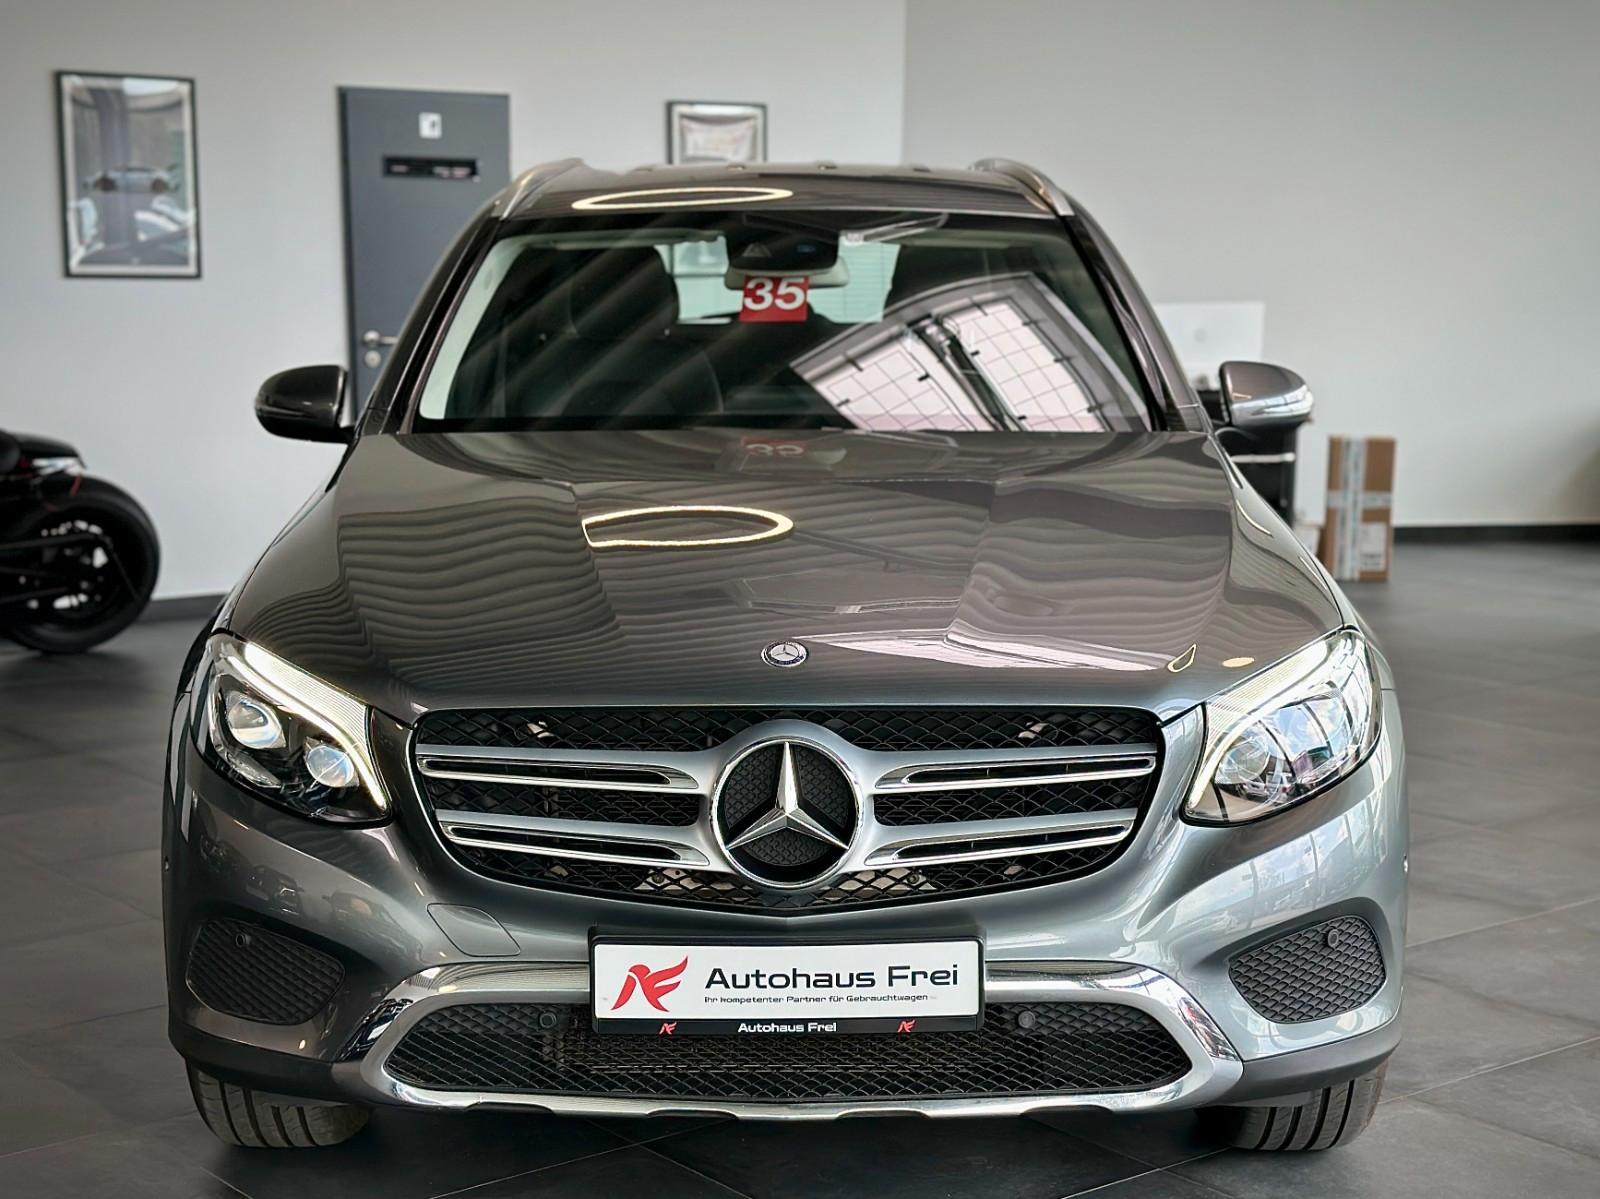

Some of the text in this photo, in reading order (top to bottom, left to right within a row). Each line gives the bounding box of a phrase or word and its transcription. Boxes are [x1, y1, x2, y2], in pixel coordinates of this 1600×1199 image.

[743, 277, 806, 310] 35
[704, 964, 958, 989] Autohaus Frei
[704, 996, 719, 1004] Ihr
[720, 995, 785, 1005] kompetenter
[786, 995, 827, 1004] Partner
[829, 995, 844, 1003] für
[846, 994, 929, 1003] Gebrauchtwagen
[737, 1022, 837, 1033] Autohaus Frei
